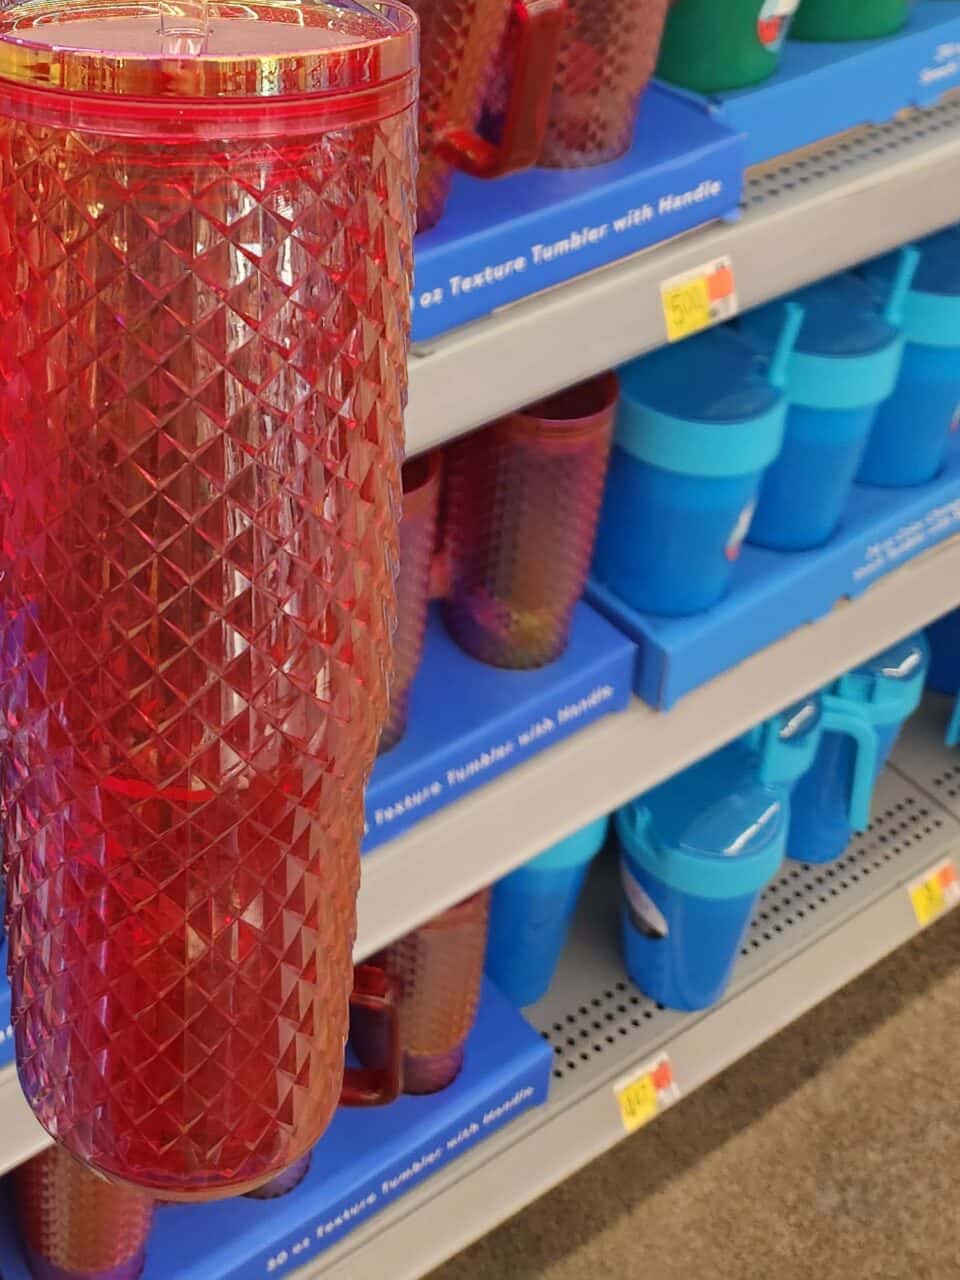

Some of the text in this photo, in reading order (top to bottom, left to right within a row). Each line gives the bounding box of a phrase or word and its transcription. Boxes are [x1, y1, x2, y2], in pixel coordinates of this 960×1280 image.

[419, 287, 443, 308] oz
[448, 256, 527, 296] Texture
[531, 223, 609, 264] Tumbler
[612, 204, 654, 233] with
[658, 179, 722, 215] Handle
